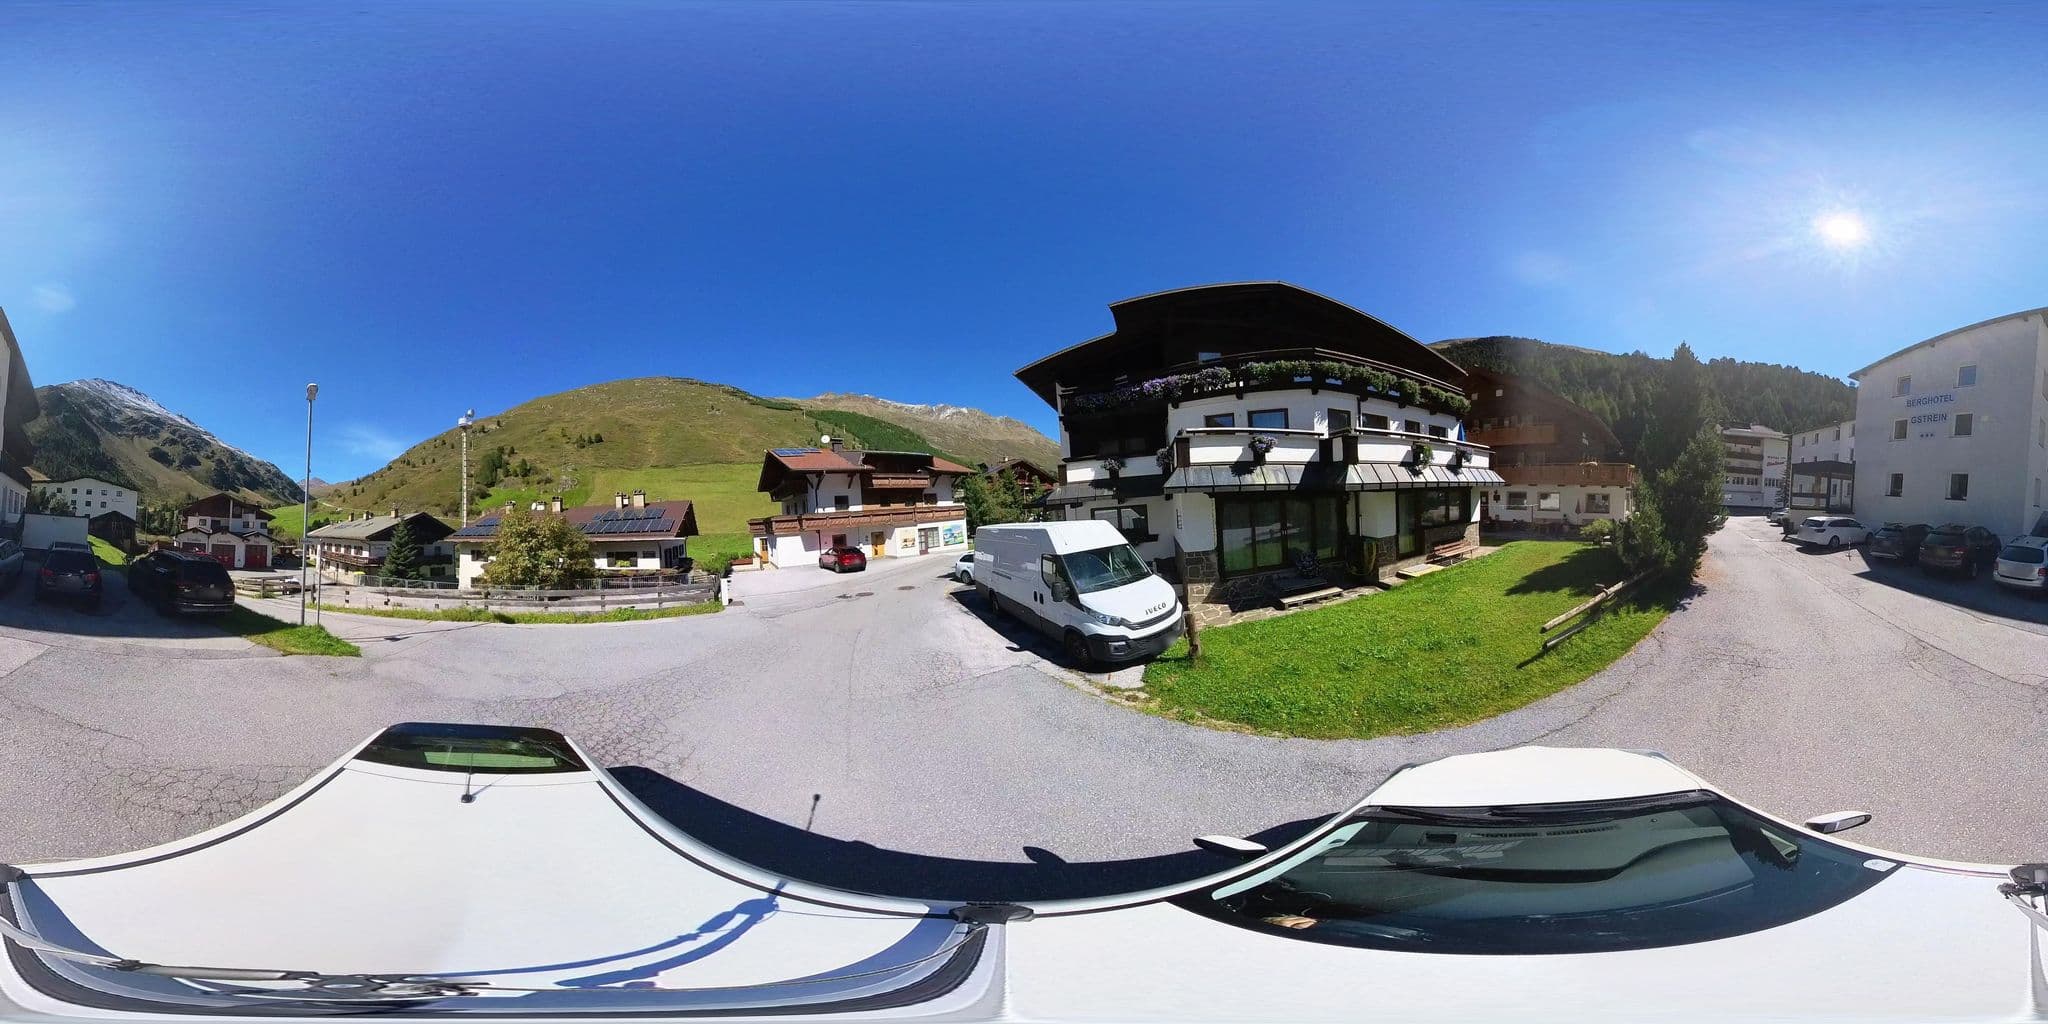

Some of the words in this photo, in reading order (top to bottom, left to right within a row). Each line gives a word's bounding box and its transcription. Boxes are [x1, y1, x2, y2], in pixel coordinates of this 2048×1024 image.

[1906, 394, 1954, 407] BERGHOTEL
[1911, 413, 1947, 424] GSTREIN
[1145, 602, 1167, 615] IVECO
